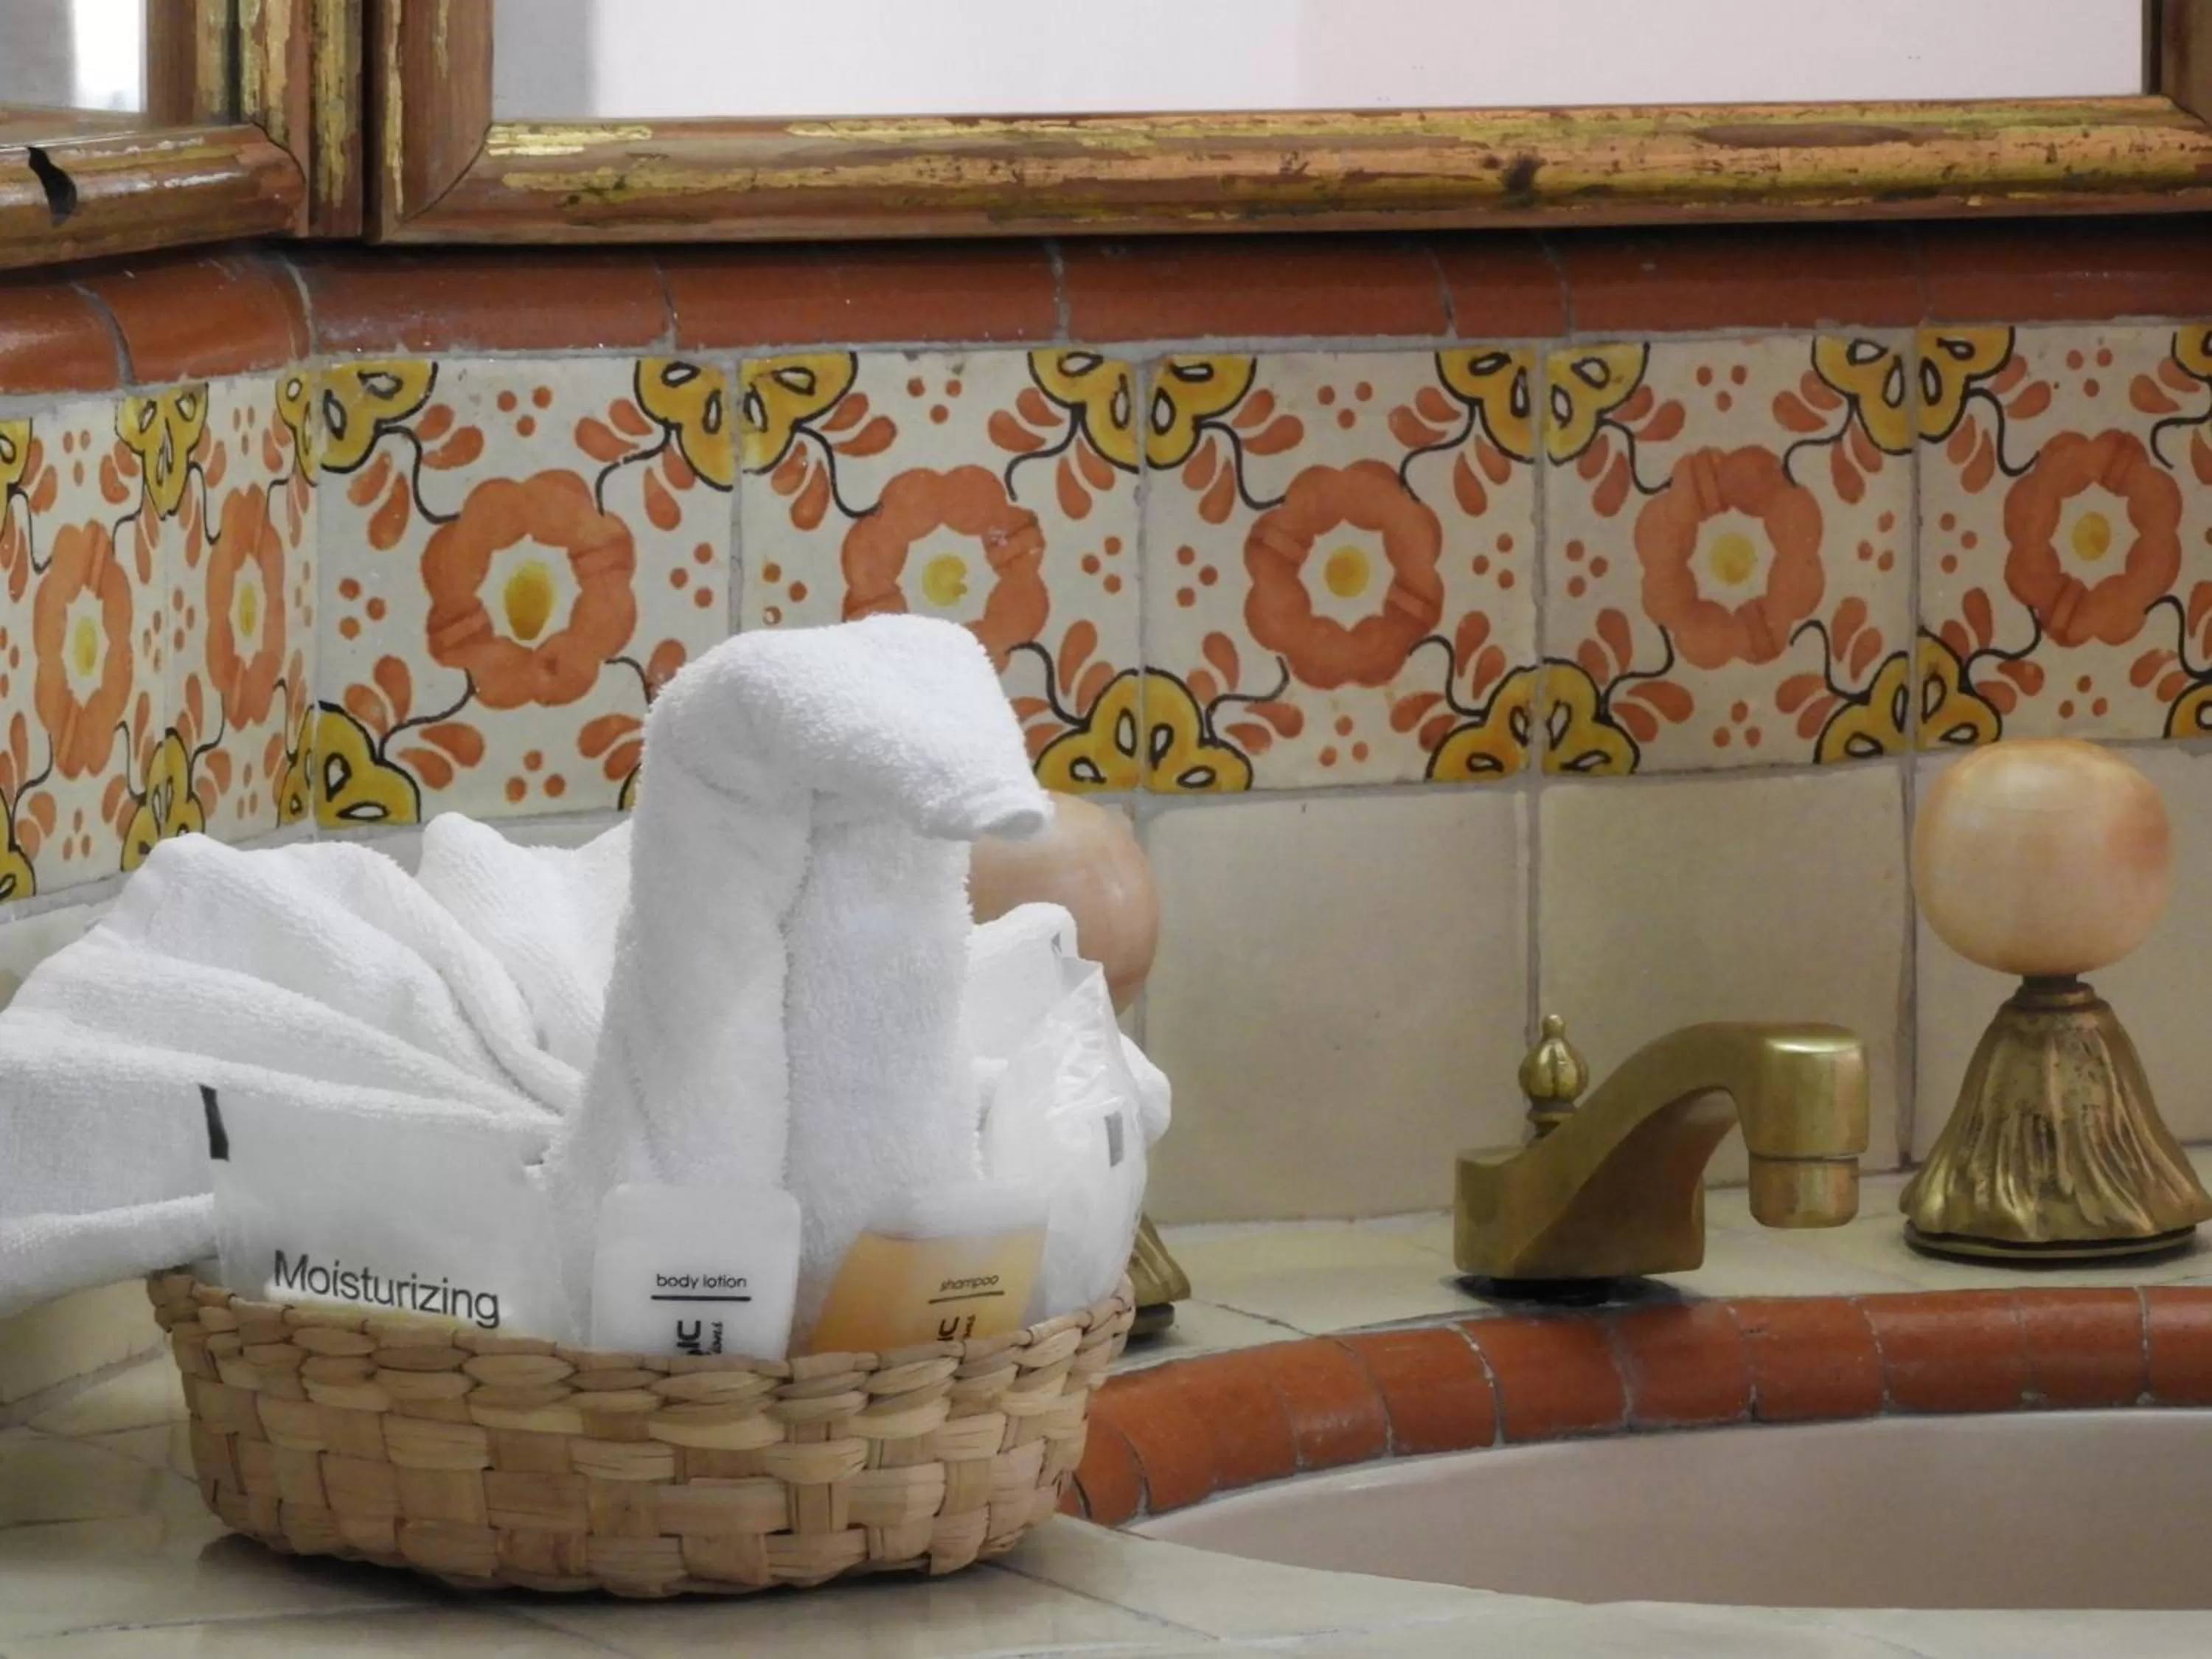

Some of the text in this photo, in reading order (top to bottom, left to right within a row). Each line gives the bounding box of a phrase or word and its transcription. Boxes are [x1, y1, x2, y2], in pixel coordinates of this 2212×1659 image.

[273, 1249, 501, 1329] Moisturizing
[655, 1273, 747, 1289] body lotion
[939, 1275, 1000, 1292] shampoo
